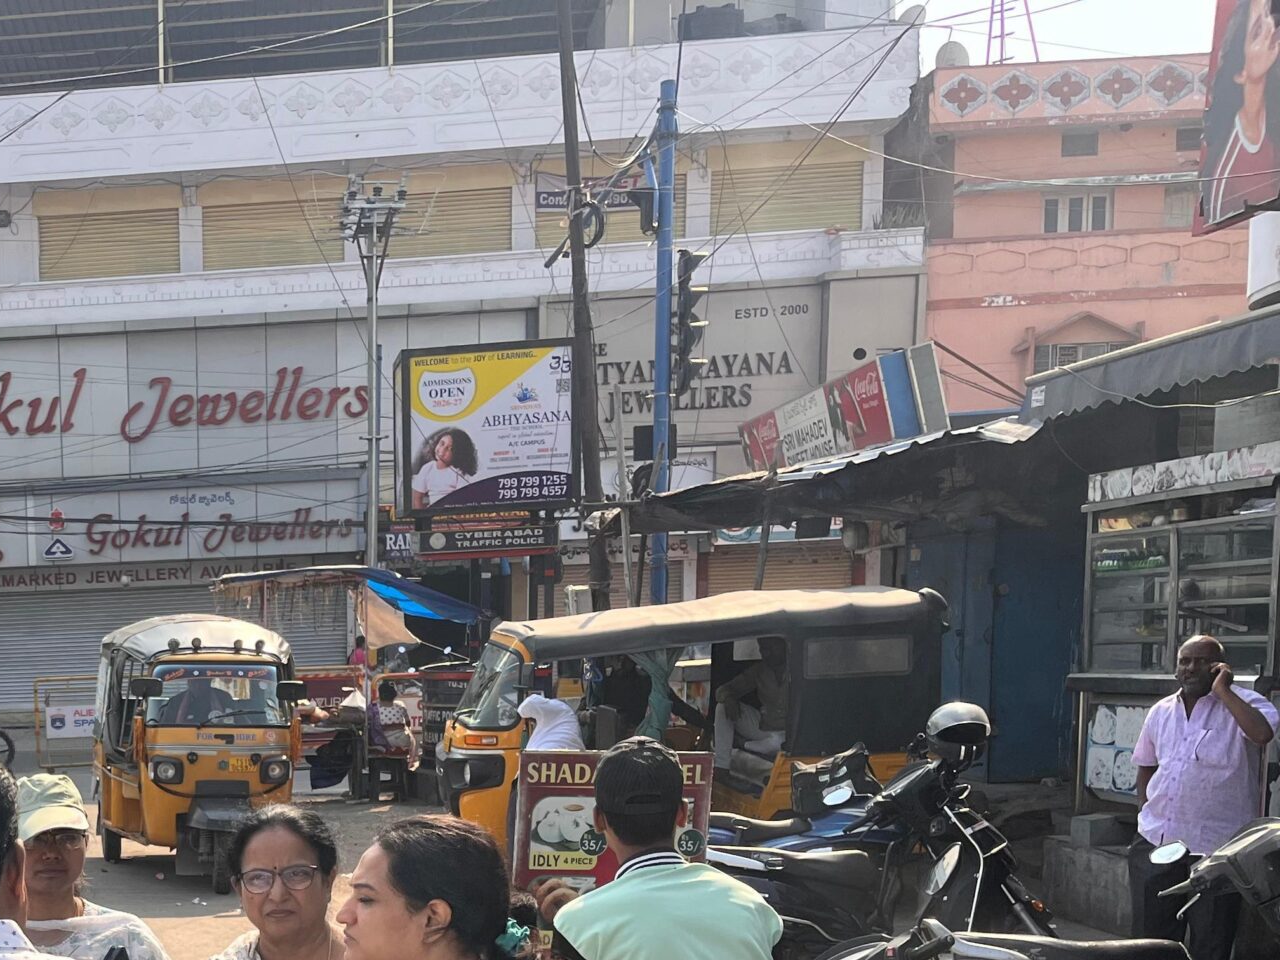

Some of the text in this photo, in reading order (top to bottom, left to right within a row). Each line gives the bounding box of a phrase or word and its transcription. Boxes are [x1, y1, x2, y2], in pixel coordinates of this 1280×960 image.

[735, 307, 769, 320] ESTD
[781, 304, 809, 317] 2000
[414, 356, 449, 367] WELCOME
[473, 352, 486, 362] JOY
[422, 376, 472, 388] ADMISSIONS
[428, 386, 465, 399] OPEN
[120, 365, 369, 444] Jewellers
[605, 383, 753, 424] JEWLLERS
[481, 409, 571, 428] ABHYASANA
[783, 417, 828, 451] SRI MAHADEV
[498, 474, 567, 489] 799 799 1255
[498, 485, 567, 499] 799 799 4557
[86, 507, 353, 556] Gokul Jewellers
[455, 528, 543, 539] CYBERABAD
[456, 536, 545, 548] TRAFFIC POLICE
[86, 564, 191, 585] JEWELLERY
[73, 708, 95, 717] ALIE
[73, 719, 96, 728] SPA
[582, 838, 607, 852] 35/-
[679, 839, 704, 852] 35/-
[532, 854, 593, 867] IDLY 4 PIECE
